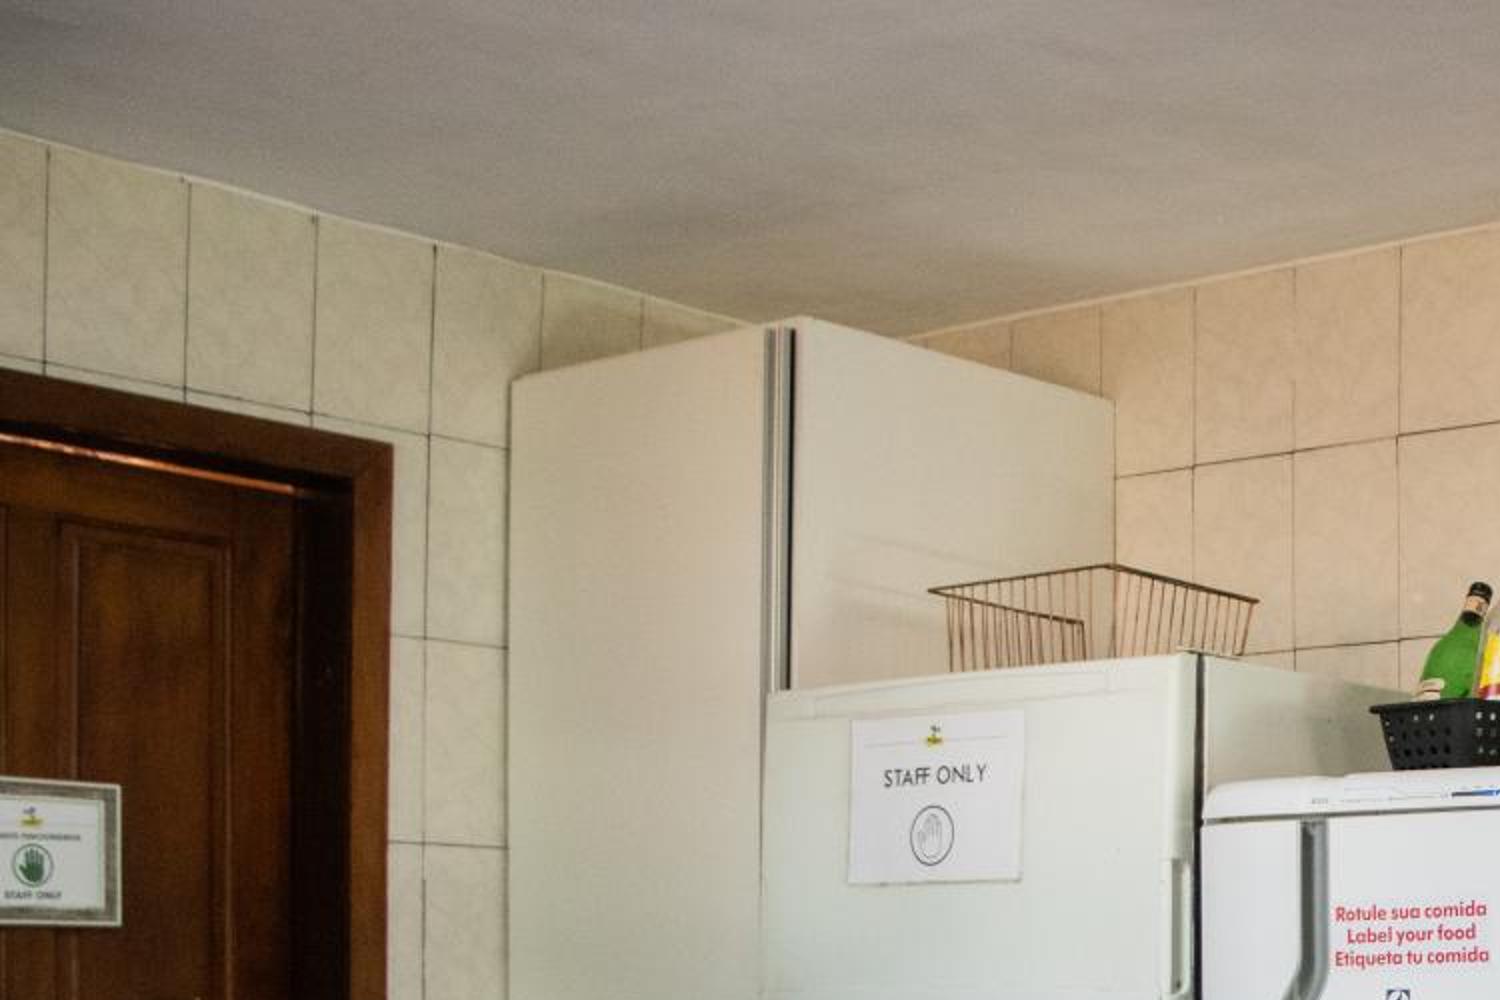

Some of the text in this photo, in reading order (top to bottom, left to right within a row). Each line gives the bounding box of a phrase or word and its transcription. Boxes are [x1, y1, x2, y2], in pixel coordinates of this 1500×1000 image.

[883, 764, 987, 789] STAFF ONLY
[4, 890, 33, 899] STAFF
[1335, 900, 1487, 922] Rotule sua comida
[1347, 923, 1476, 946] Label your food
[1335, 946, 1489, 970] Etiqueta tu comida
